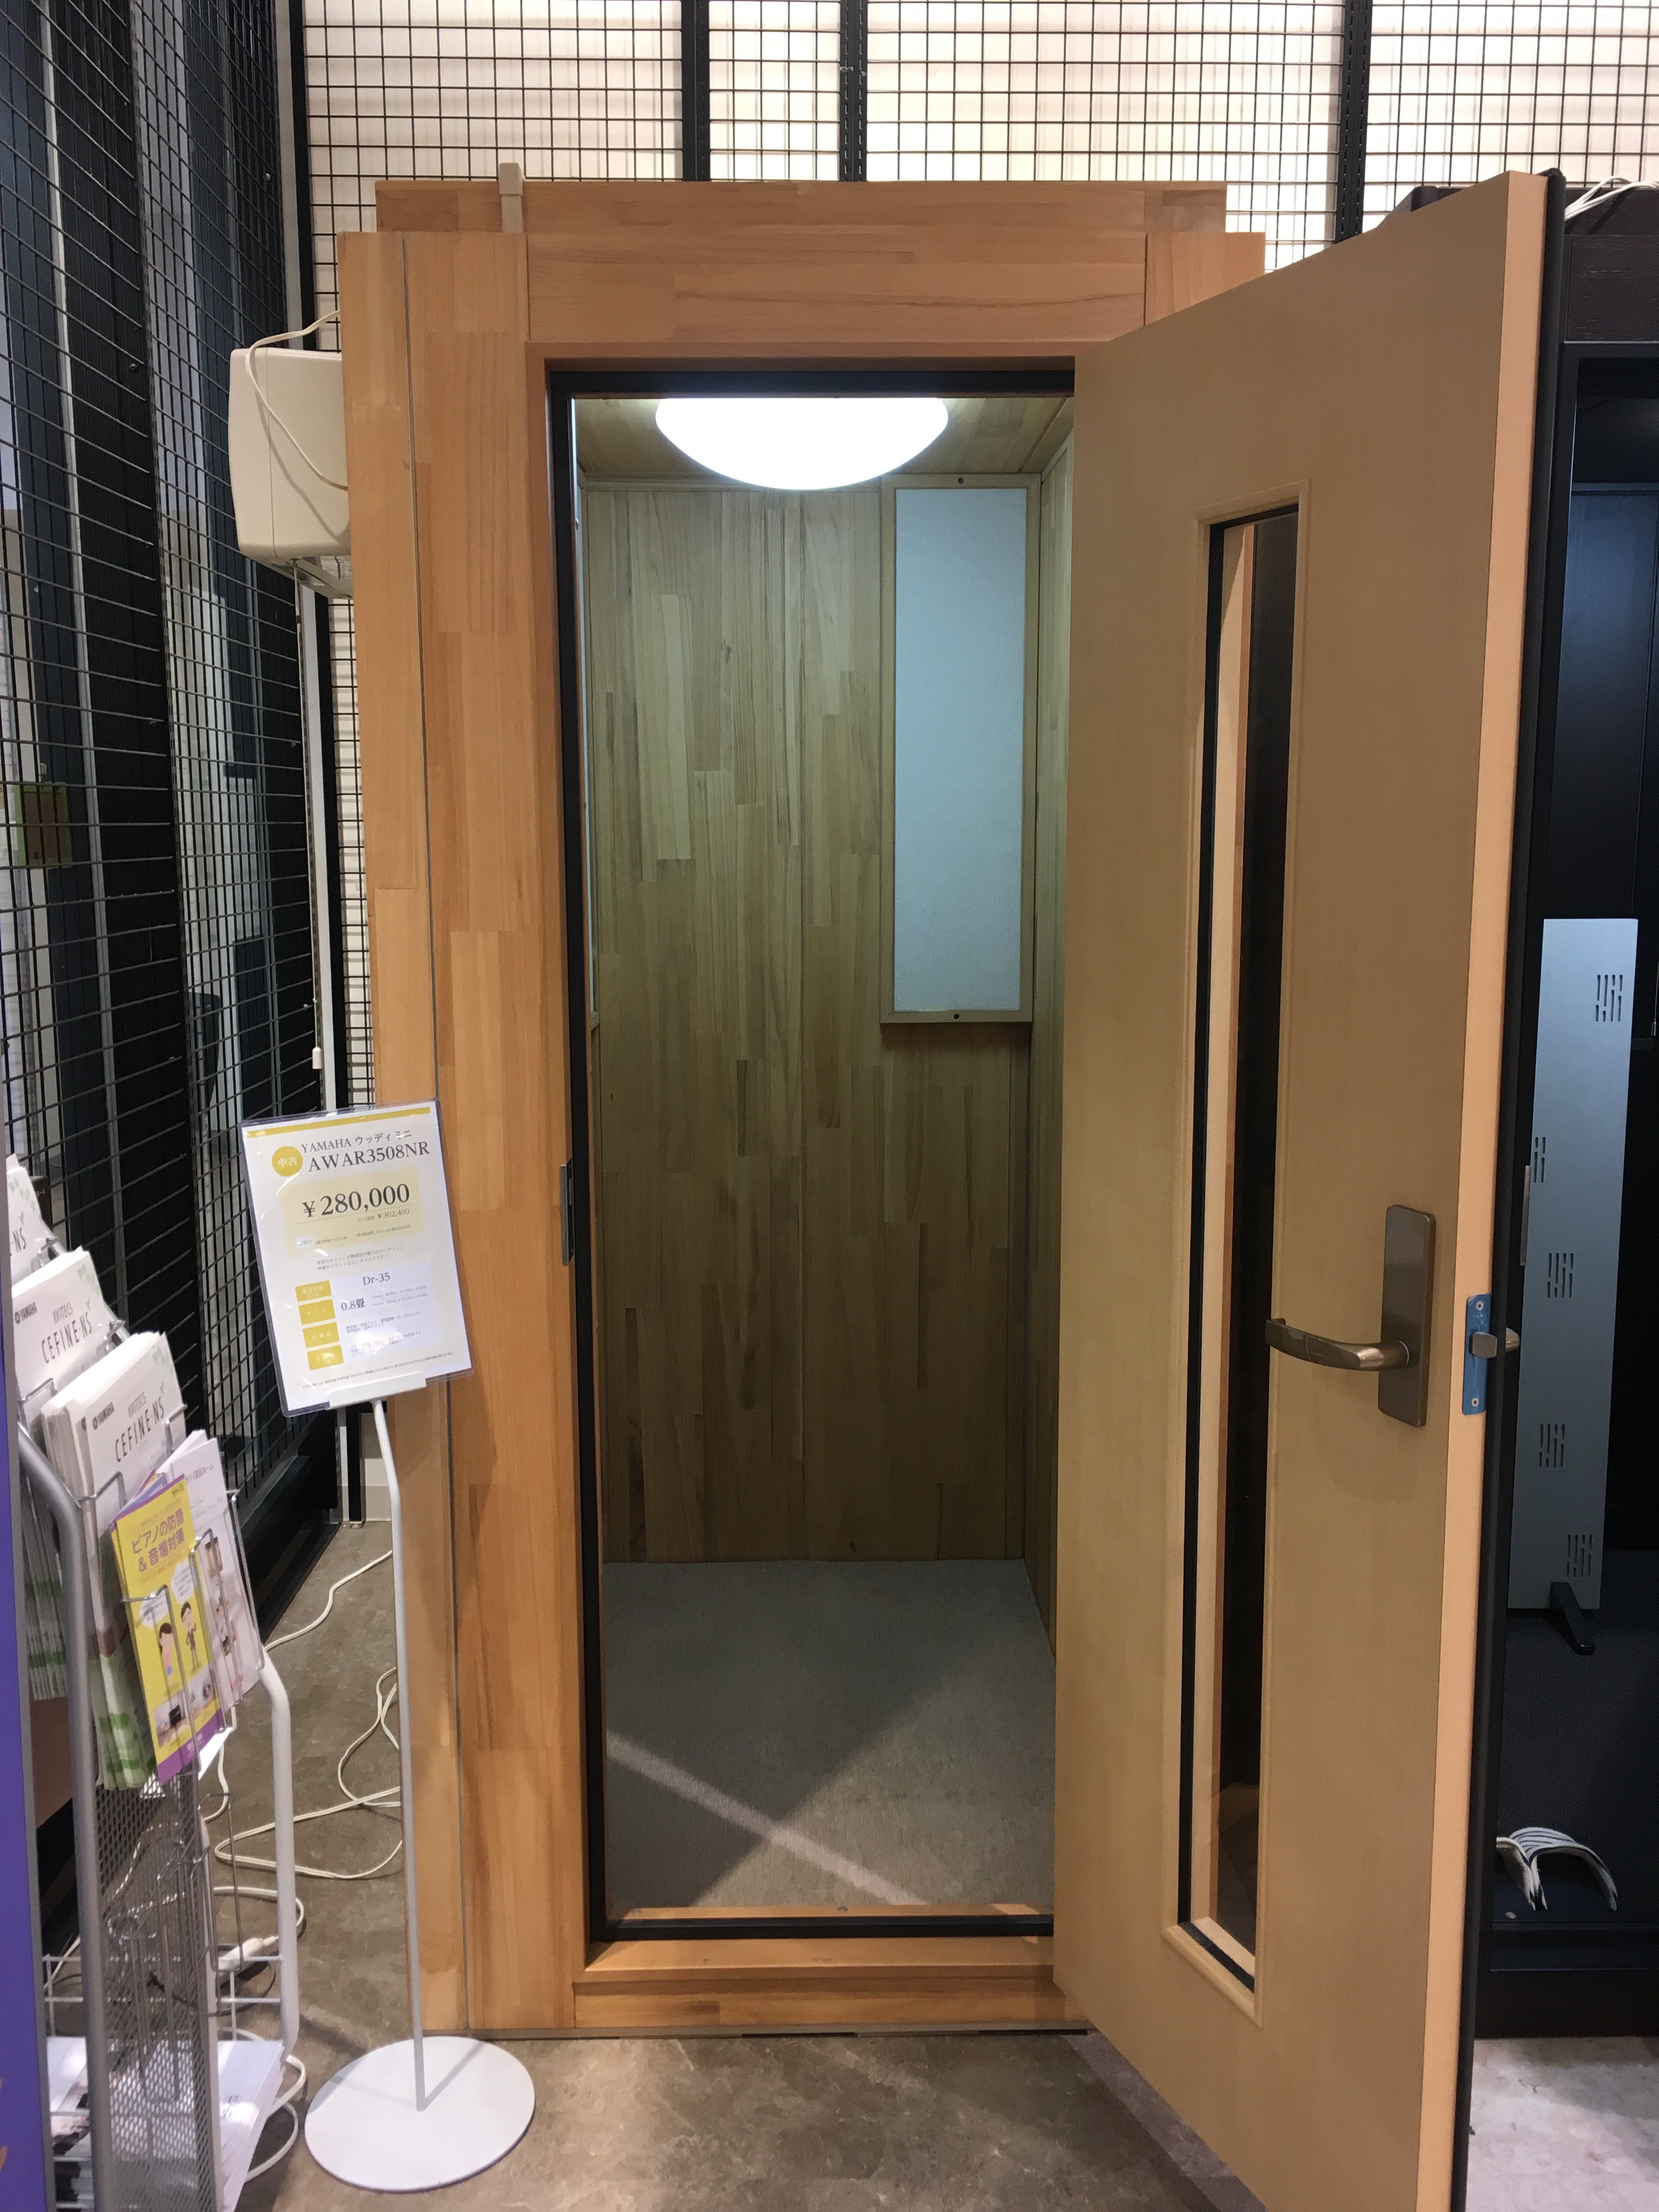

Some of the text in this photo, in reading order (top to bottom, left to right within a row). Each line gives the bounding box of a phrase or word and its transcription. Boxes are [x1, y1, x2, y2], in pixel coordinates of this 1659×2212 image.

[301, 1137, 352, 1153] YAMAHA
[277, 1156, 297, 1167] 中古
[308, 1141, 430, 1172] AWAR3508NR
[363, 1272, 391, 1285] Dr-35
[341, 1297, 365, 1311] 0.8畳
[131, 1508, 184, 1554] ピアノの防音
